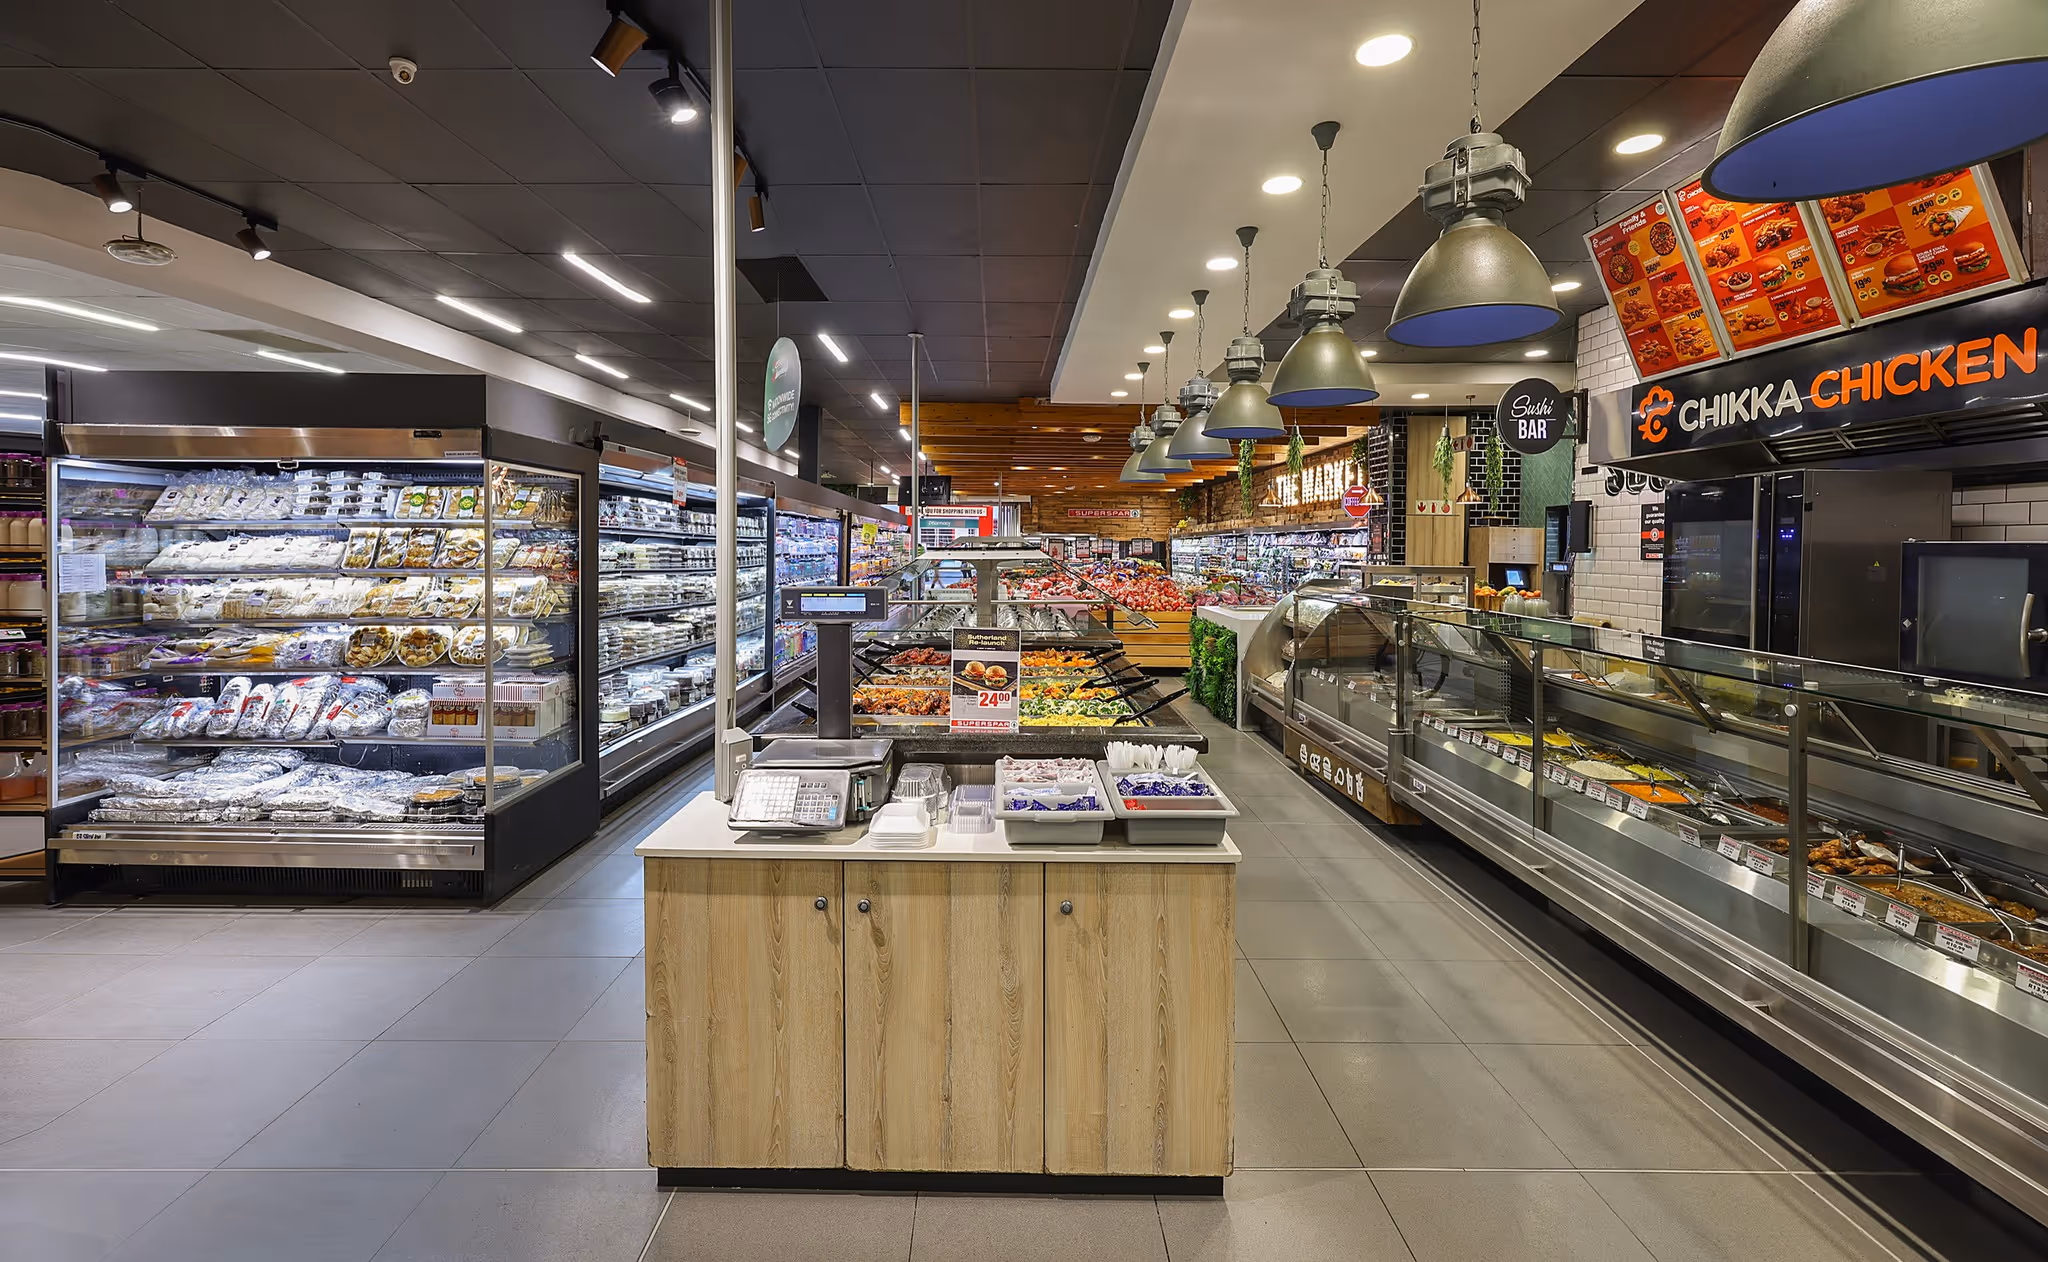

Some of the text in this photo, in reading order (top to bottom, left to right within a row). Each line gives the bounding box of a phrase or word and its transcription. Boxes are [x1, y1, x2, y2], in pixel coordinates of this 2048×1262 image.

[1619, 213, 1640, 229] Family
[1622, 218, 1647, 234] Friends
[1679, 327, 2038, 431] CHIKKA CHICKEN
[1511, 395, 1553, 418] Sushi
[1518, 419, 1547, 439] BAR
[1276, 457, 1366, 507] THE MARKET
